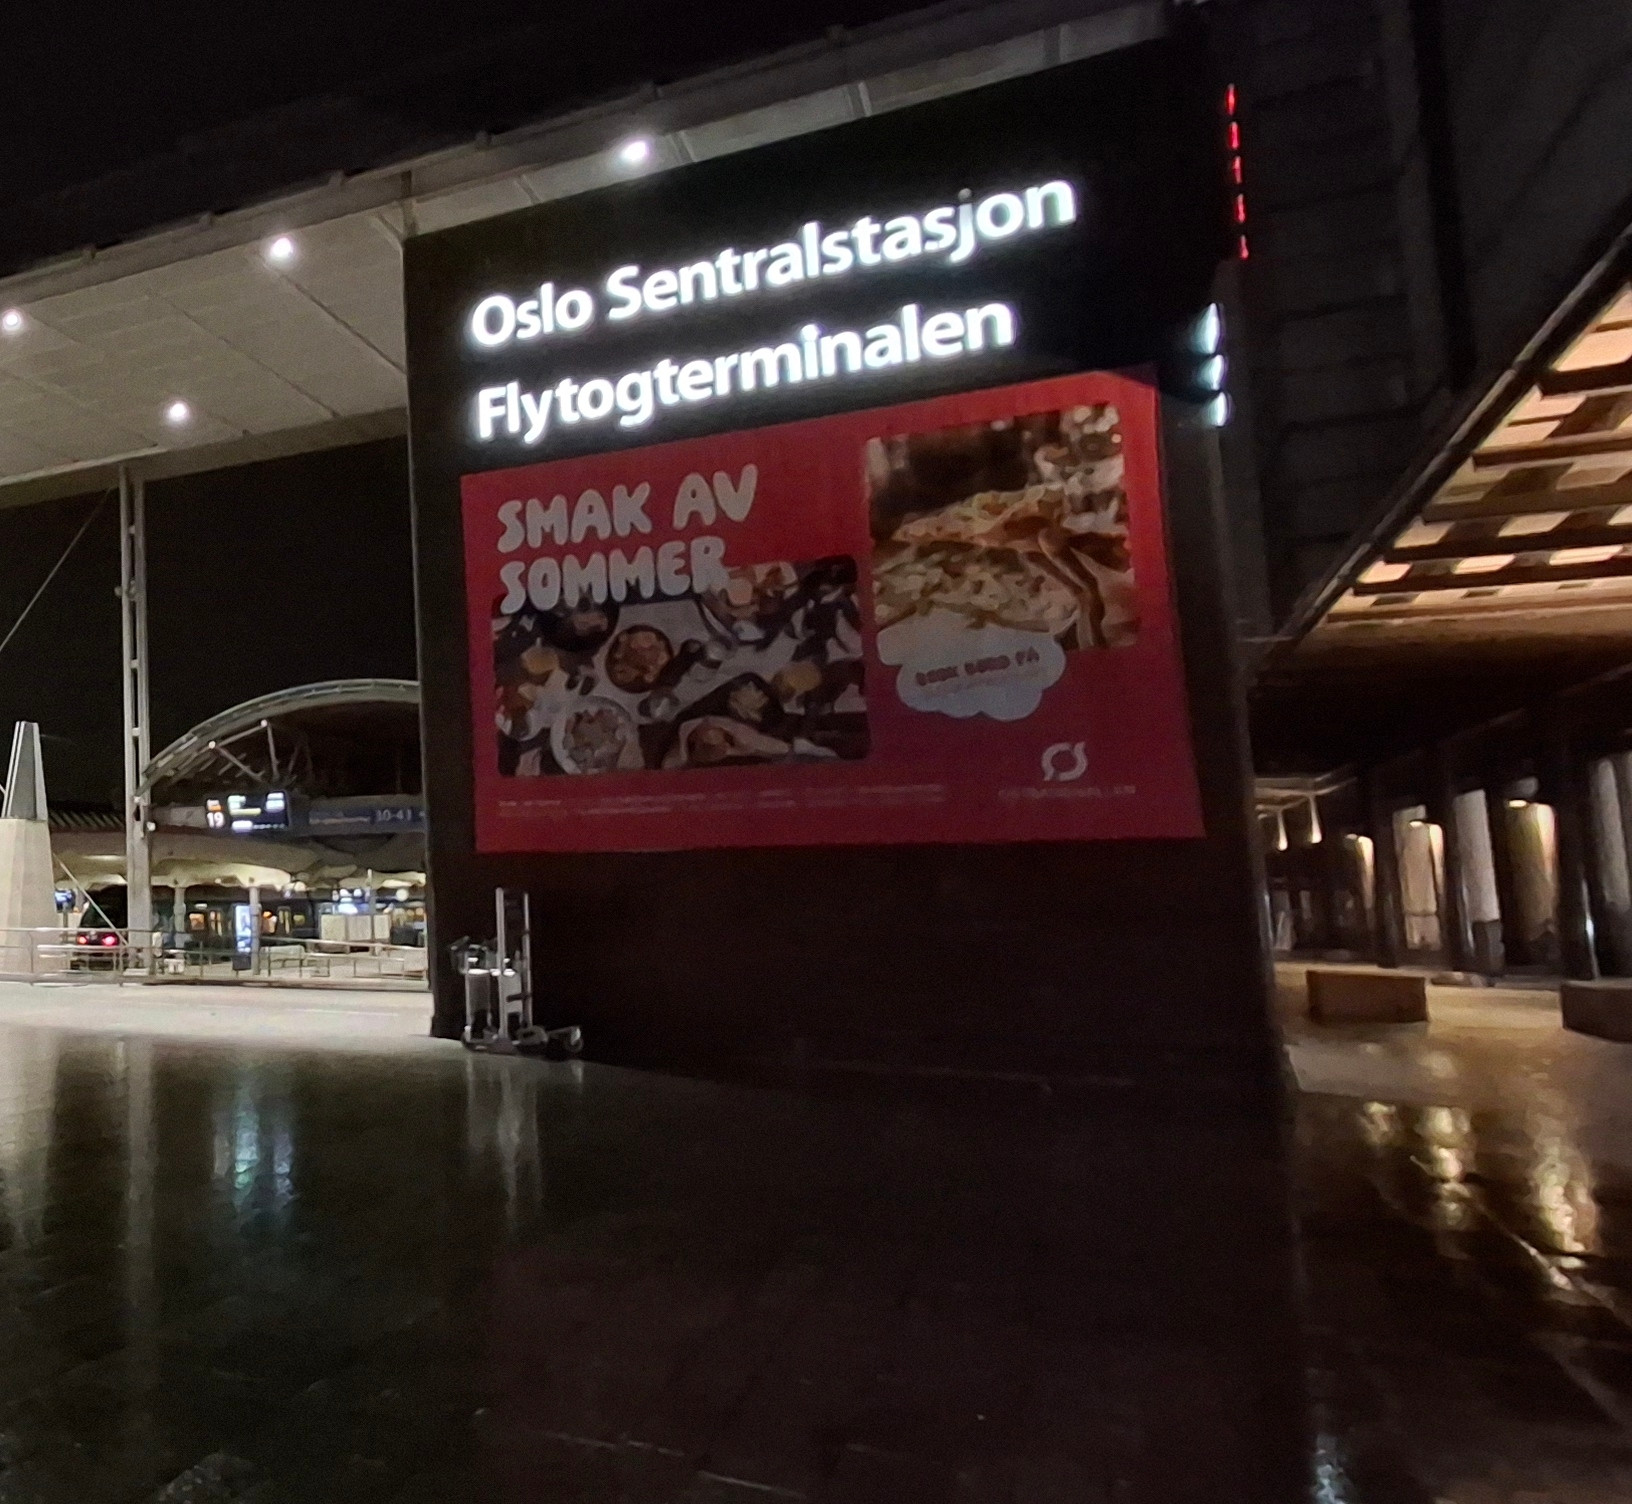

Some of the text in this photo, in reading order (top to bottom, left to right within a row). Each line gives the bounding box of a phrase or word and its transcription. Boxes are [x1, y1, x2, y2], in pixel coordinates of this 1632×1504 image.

[470, 178, 1077, 347] Oslo Sentralstasjon
[477, 301, 1016, 444] Flytogterminalen
[497, 463, 759, 553] SMAK AV
[499, 535, 730, 616] SOMMER
